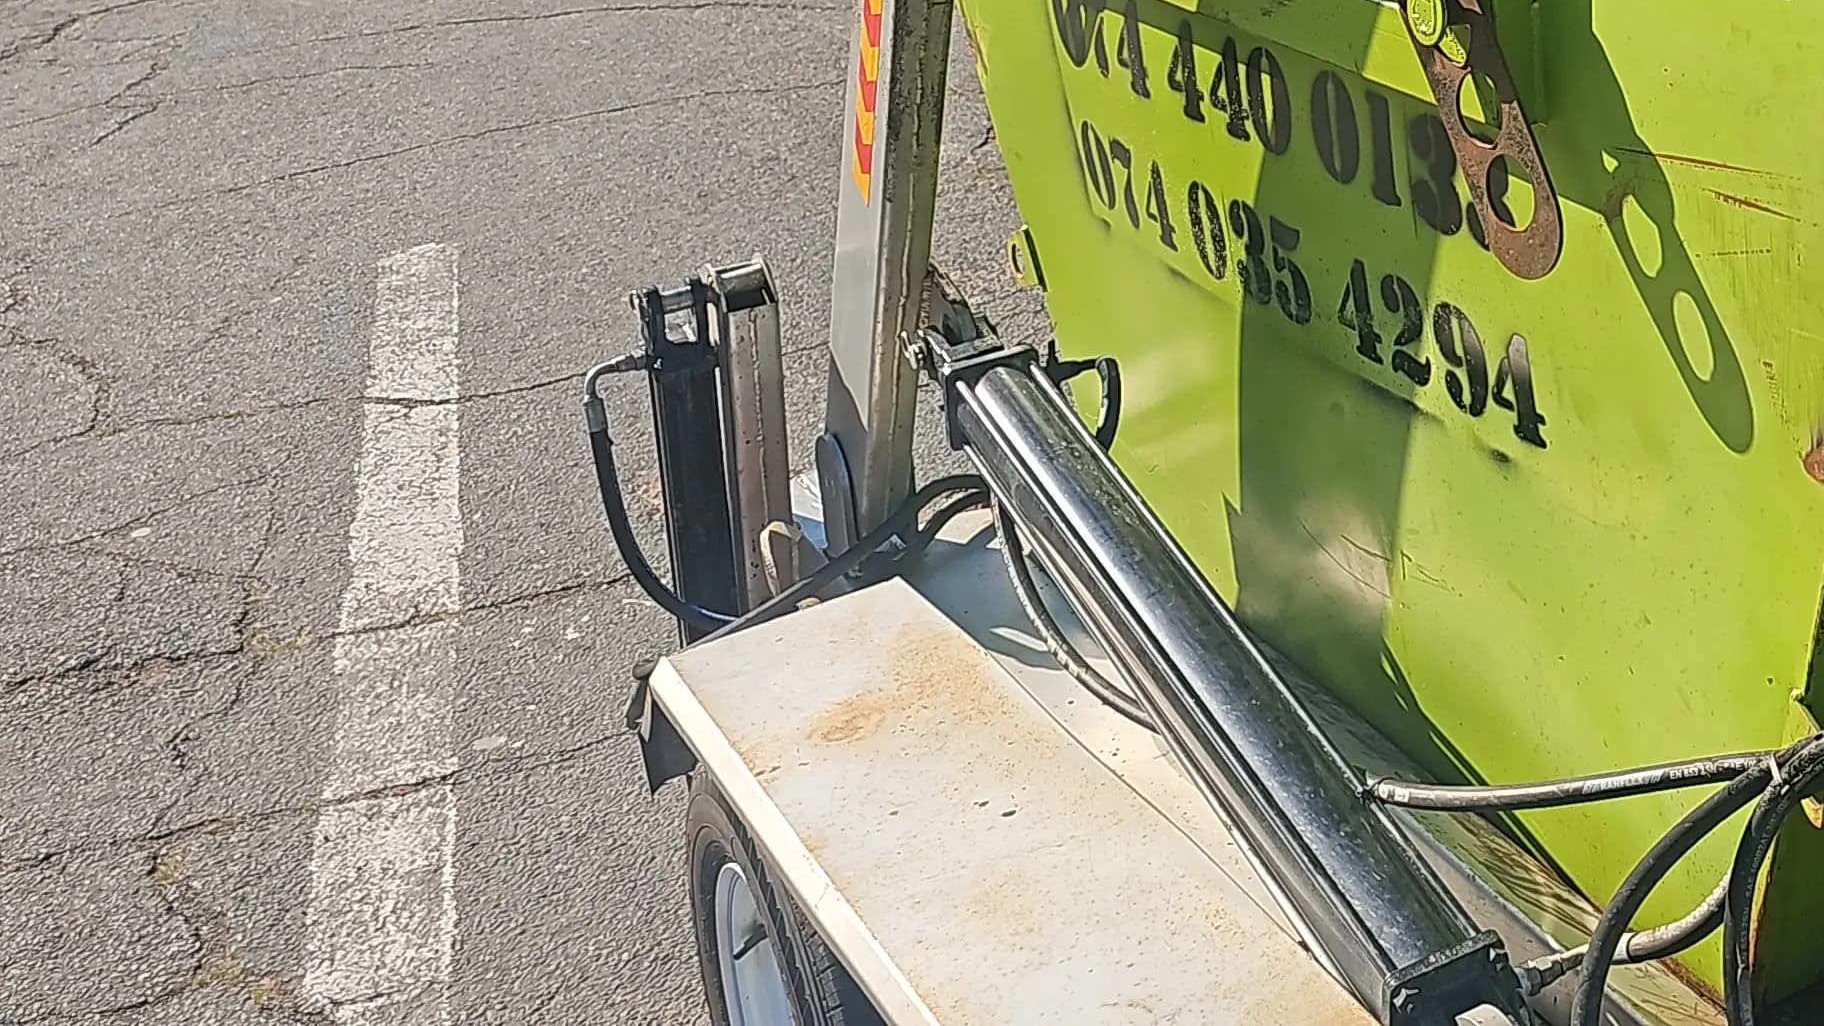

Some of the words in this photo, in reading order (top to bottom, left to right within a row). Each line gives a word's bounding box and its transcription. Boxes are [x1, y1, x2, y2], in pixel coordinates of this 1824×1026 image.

[1168, 18, 1291, 156] 440
[1081, 122, 1178, 253] 074
[1188, 180, 1312, 326] 035
[1338, 258, 1548, 450] 4294
